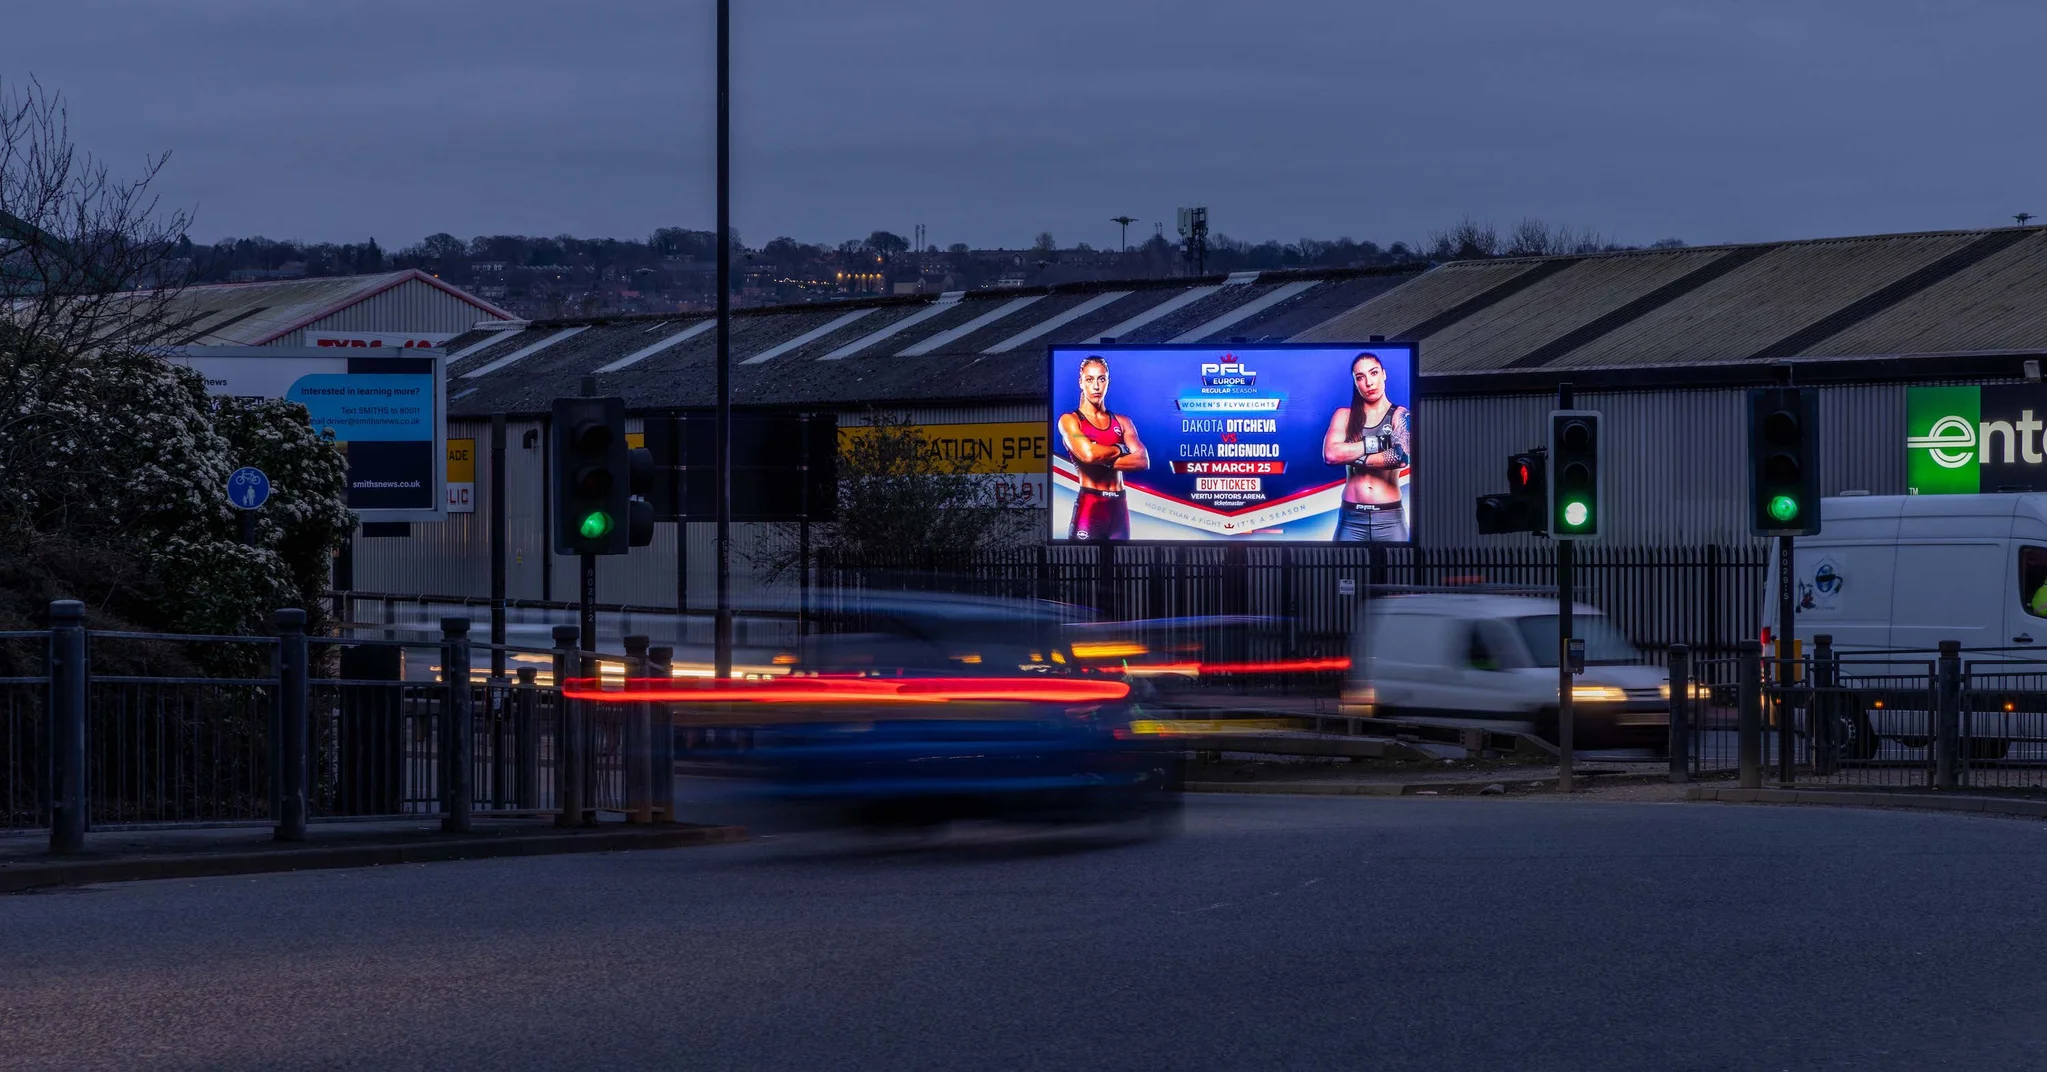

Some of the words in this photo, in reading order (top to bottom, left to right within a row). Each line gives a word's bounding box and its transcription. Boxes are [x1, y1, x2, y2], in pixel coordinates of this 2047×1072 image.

[1201, 363, 1257, 376] PFL
[1213, 377, 1246, 385] EUROPE
[301, 387, 345, 395] Interested
[347, 387, 355, 395] in
[357, 387, 391, 397] learning
[393, 387, 420, 395] more?
[341, 406, 356, 415] Text
[358, 406, 389, 415] SMITHS
[391, 406, 398, 415] to
[400, 406, 420, 415] 80011
[327, 416, 420, 426] driver@smithsnews.co.uk
[1182, 419, 1224, 432] DAKOTA
[1227, 419, 1276, 432] DITCHEVA
[1221, 433, 1237, 443] VS
[1002, 437, 1046, 459] SPE
[1180, 444, 1215, 457] CLARA
[1217, 444, 1280, 457] RICIGNUOLO
[447, 450, 469, 461] ADE
[1187, 463, 1209, 473] SAT
[1212, 463, 1255, 473] MARCH
[1258, 463, 1271, 473] 25
[352, 479, 421, 489] smithsnews.co.uk
[1201, 479, 1217, 490] BUY
[1220, 479, 1257, 490] TICKETS
[446, 489, 469, 503] LIC
[1356, 503, 1380, 511] PFL
[1145, 501, 1166, 513] MORE
[1169, 509, 1188, 520] THAN
[1198, 517, 1221, 528] FIGHT
[1237, 519, 1255, 528] IT'S
[1270, 504, 1307, 520] SEASON
